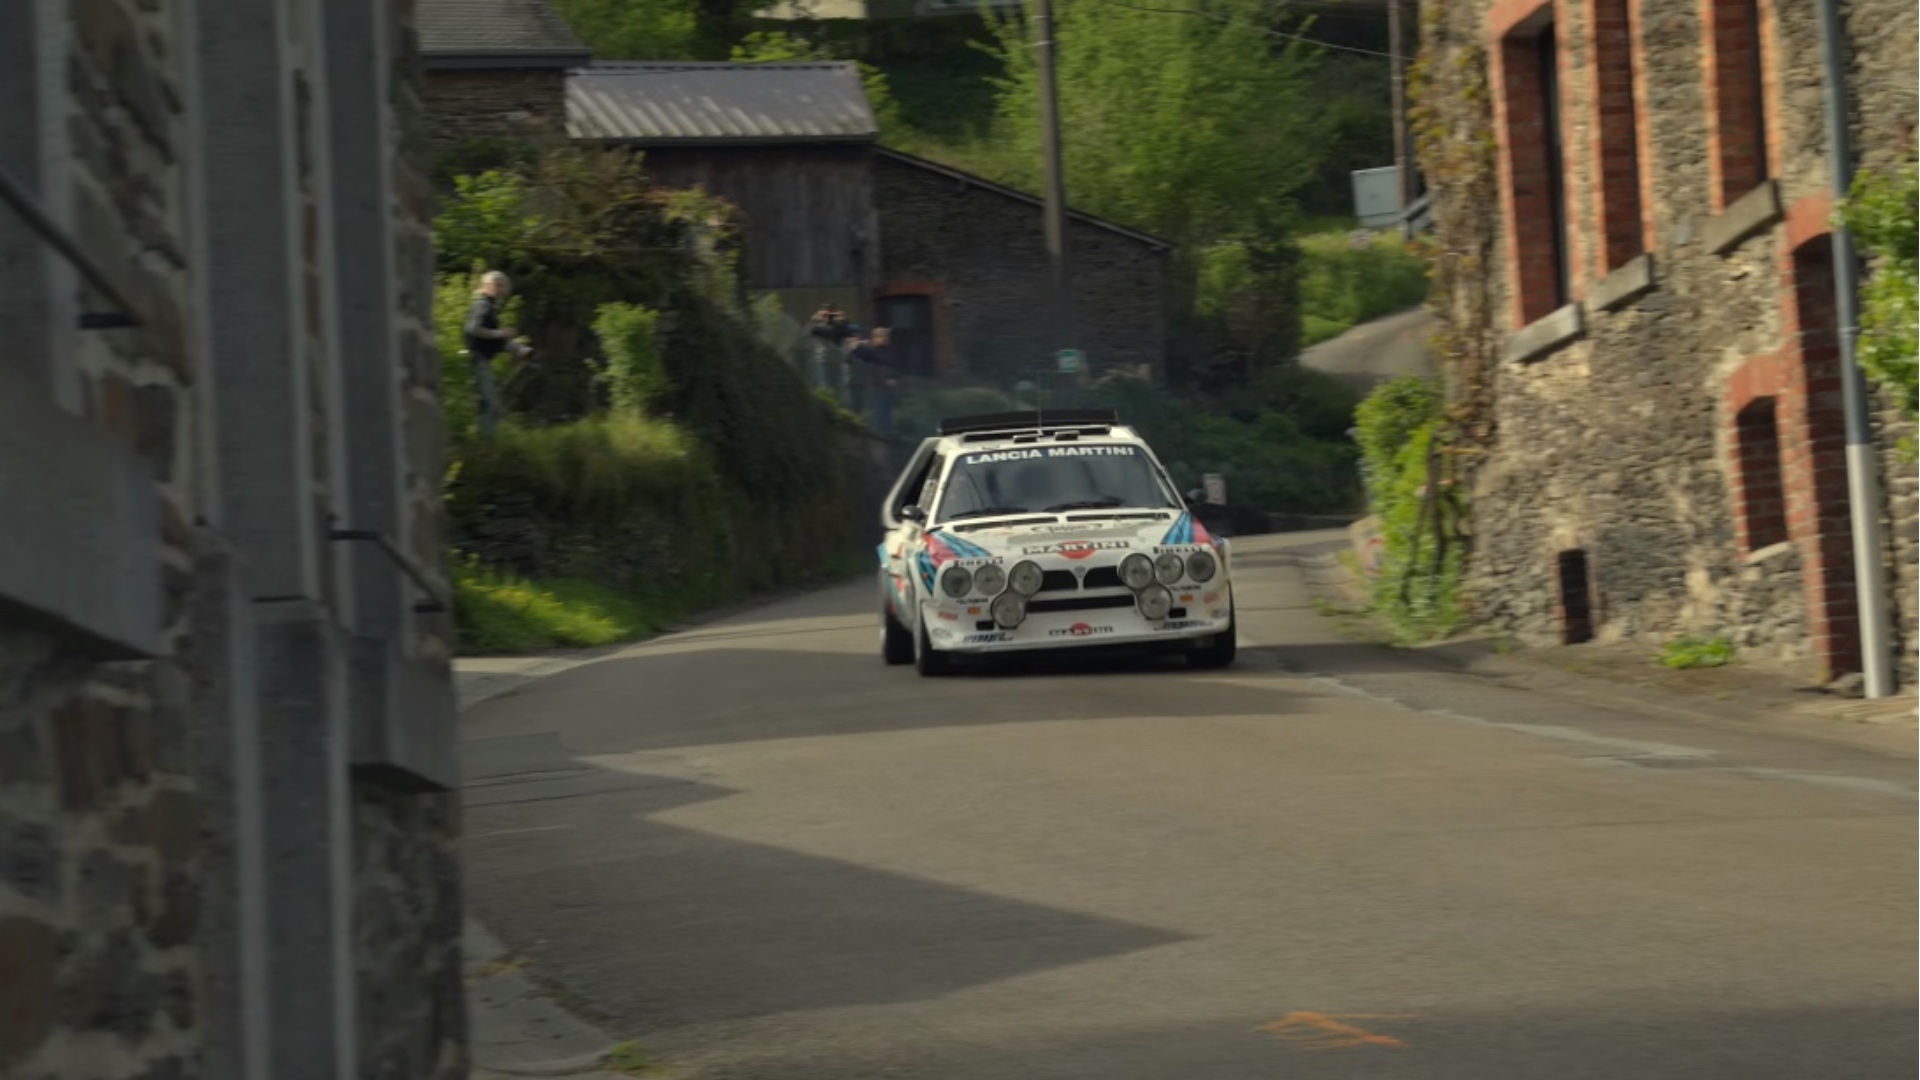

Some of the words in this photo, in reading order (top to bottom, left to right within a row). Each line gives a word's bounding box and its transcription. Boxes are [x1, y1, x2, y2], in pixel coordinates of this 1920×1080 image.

[966, 449, 1042, 465] LANCIA
[1048, 446, 1134, 457] MARTINI
[1022, 540, 1130, 555] MARTINI
